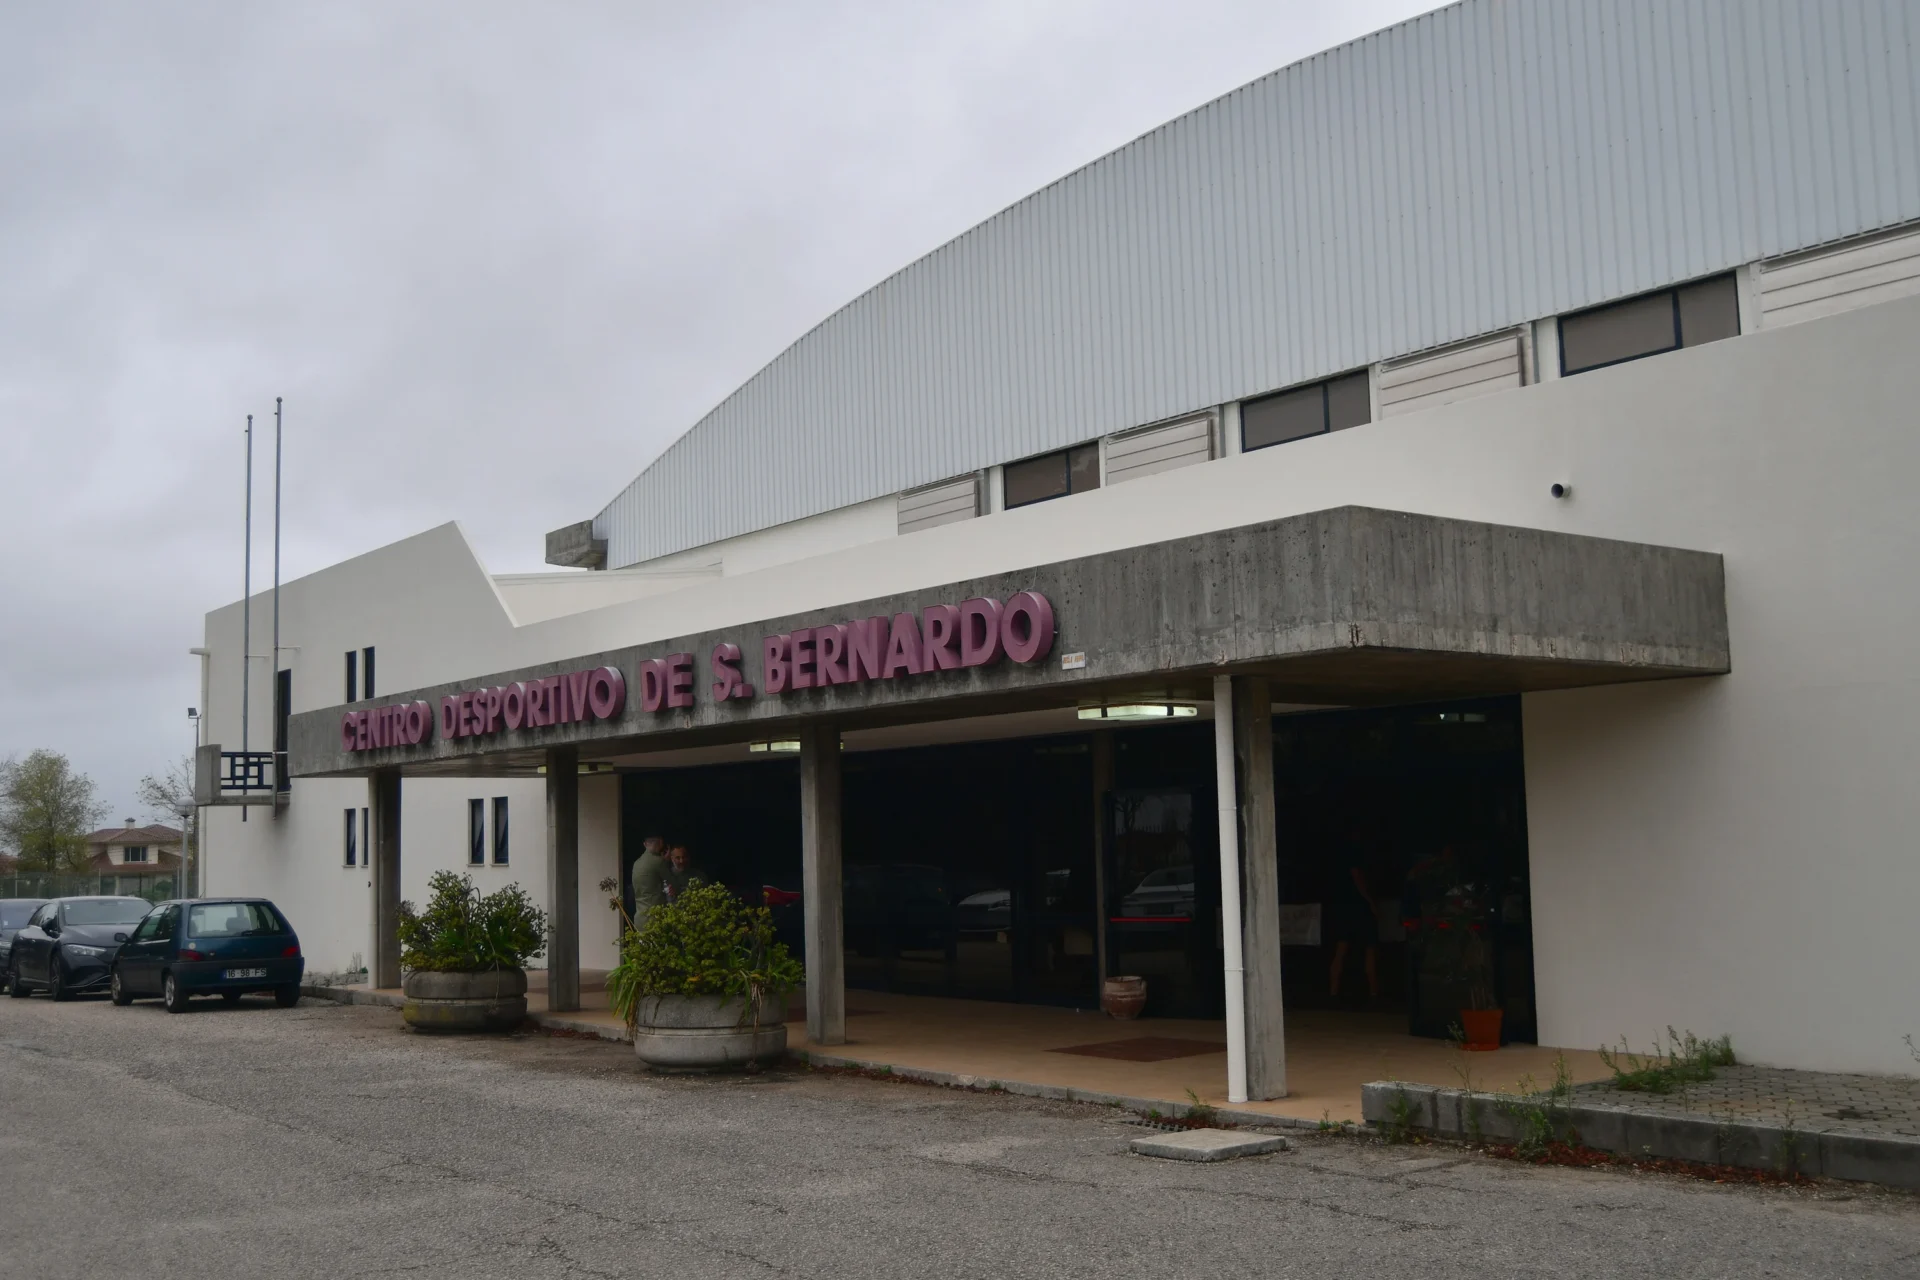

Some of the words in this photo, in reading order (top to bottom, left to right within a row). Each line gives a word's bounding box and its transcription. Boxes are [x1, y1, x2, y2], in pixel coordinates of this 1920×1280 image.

[341, 700, 432, 750] CENTRO
[441, 666, 625, 740] DESPORTIVO
[640, 652, 694, 712] DE
[711, 643, 752, 701] S.
[764, 591, 1054, 695] BERNARDO
